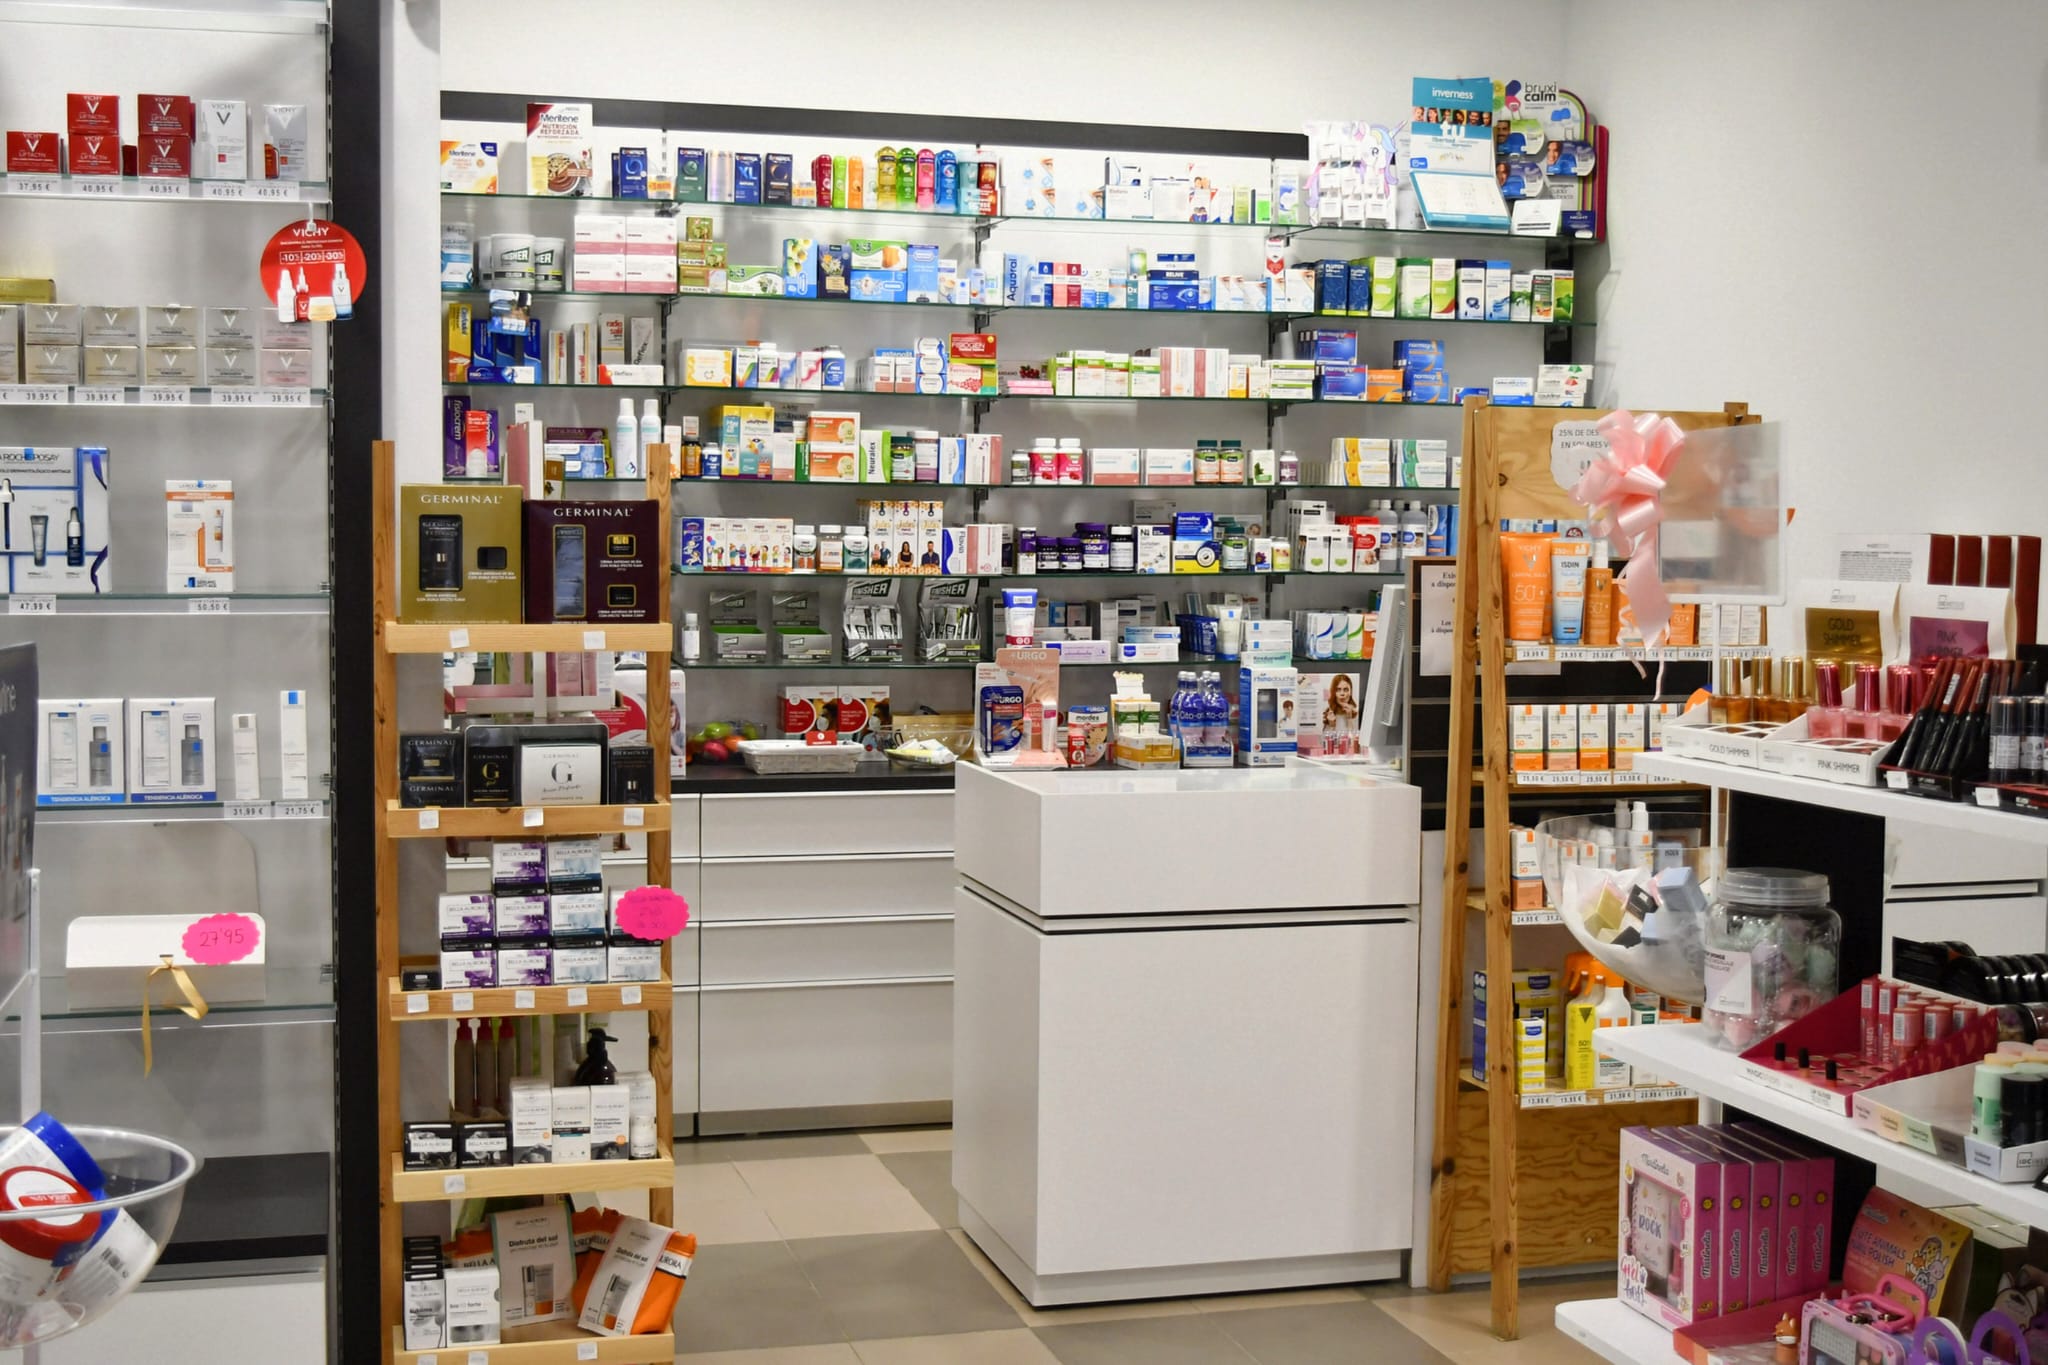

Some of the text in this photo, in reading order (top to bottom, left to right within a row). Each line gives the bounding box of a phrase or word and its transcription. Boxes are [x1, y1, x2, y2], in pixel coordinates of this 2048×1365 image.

[1431, 87, 1473, 100] inverness
[1525, 81, 1557, 93] bruxi
[1524, 91, 1557, 103] calm
[540, 113, 579, 123] Meritene
[1440, 121, 1465, 138] tu
[738, 166, 757, 180] XL
[292, 227, 329, 238] VICHY
[1007, 258, 1018, 302] Aquoral
[453, 400, 461, 441] fisiocrem
[1558, 429, 1574, 437] 25%
[1560, 441, 1571, 449] EN
[868, 441, 876, 475] Neuralex
[420, 494, 500, 505] GERMINAL
[553, 507, 632, 517] GERMINAL
[853, 578, 888, 595] FINISHER
[929, 579, 966, 596] FINISHER
[1828, 617, 1854, 632] GOLD
[1823, 632, 1862, 647] SHIMMER
[1936, 630, 1958, 643] PINK
[1016, 651, 1047, 661] URGO
[999, 696, 1022, 704] URGO
[1708, 744, 1751, 759] GOLD SHIMMER
[1817, 759, 1861, 774] PINK SHIMMER
[258, 807, 263, 815] €
[310, 806, 315, 814] €
[1639, 1214, 1663, 1239] ROCK
[509, 1234, 559, 1249] Disfruta del sol
[1873, 1238, 1907, 1260] ANIMALS
[1867, 1247, 1895, 1267] POLISH
